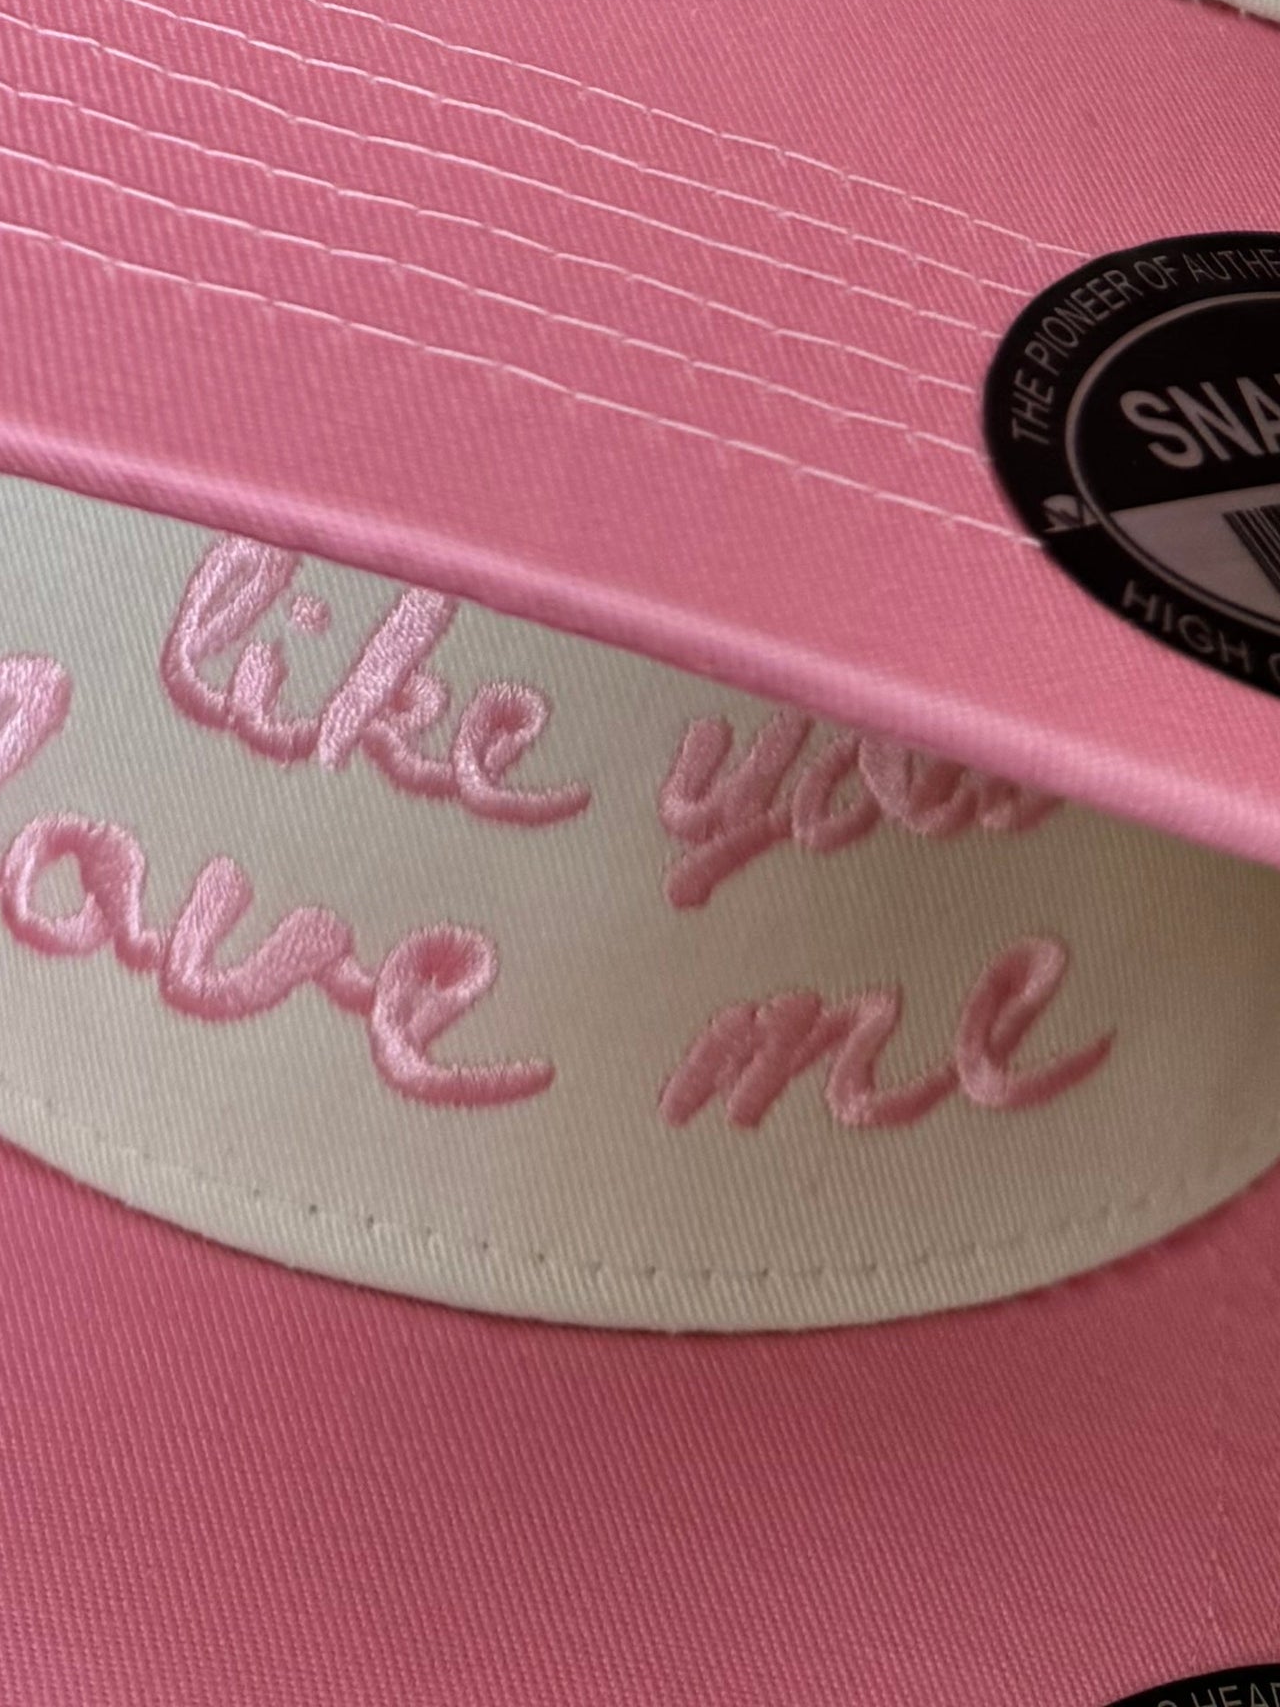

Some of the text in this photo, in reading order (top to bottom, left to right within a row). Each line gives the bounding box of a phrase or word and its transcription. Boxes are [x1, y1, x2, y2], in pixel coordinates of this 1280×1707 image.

[1133, 255, 1179, 289] OF
[1024, 269, 1144, 376] PIONEER
[1012, 369, 1055, 445] THE
[1122, 580, 1253, 674] HIGH
[161, 535, 591, 827] like
[658, 935, 1119, 1128] me
